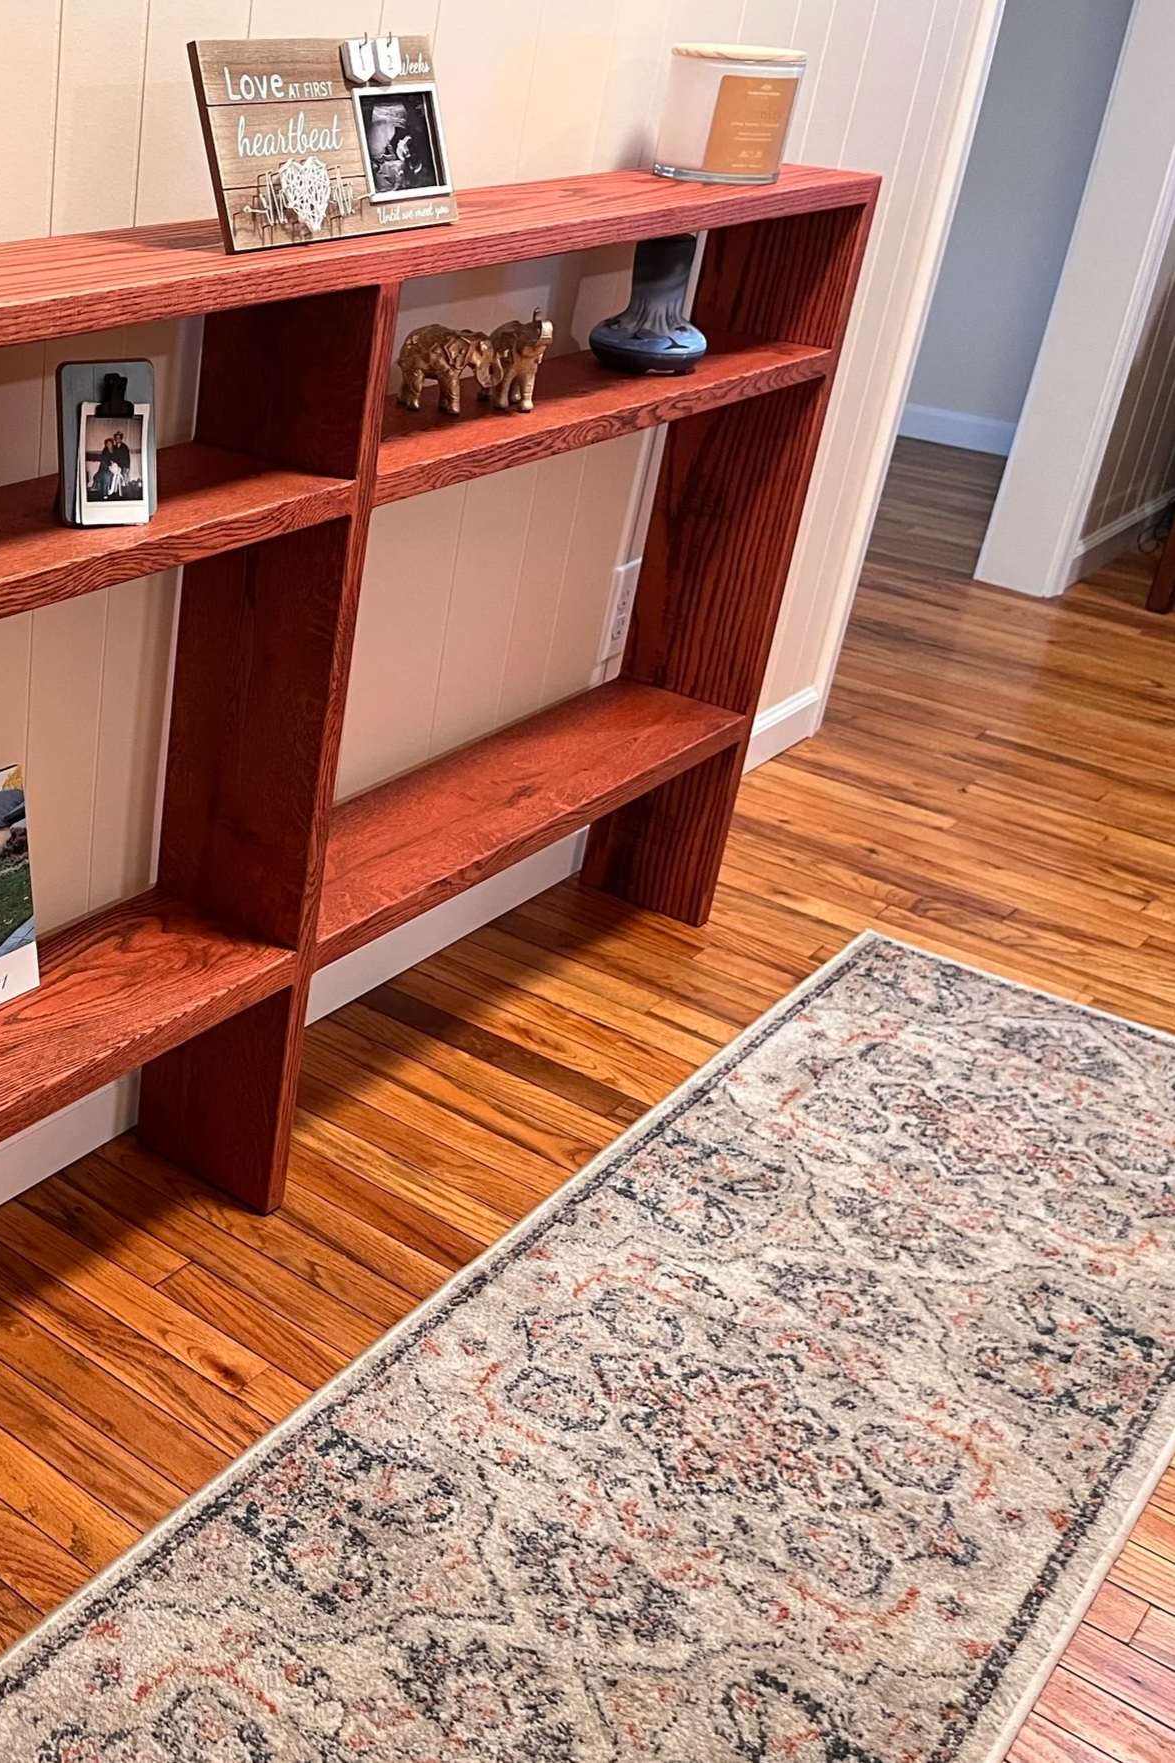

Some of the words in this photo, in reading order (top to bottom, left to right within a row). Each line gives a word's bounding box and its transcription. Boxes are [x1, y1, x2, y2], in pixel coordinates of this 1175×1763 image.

[386, 54, 394, 71] 2
[224, 66, 285, 101] Love
[288, 83, 301, 99] AT
[303, 81, 333, 98] FIRST
[238, 111, 344, 157] heartbeat
[377, 205, 400, 224] Until
[401, 209, 414, 220] we
[415, 202, 434, 217] meet
[434, 205, 450, 220] you
